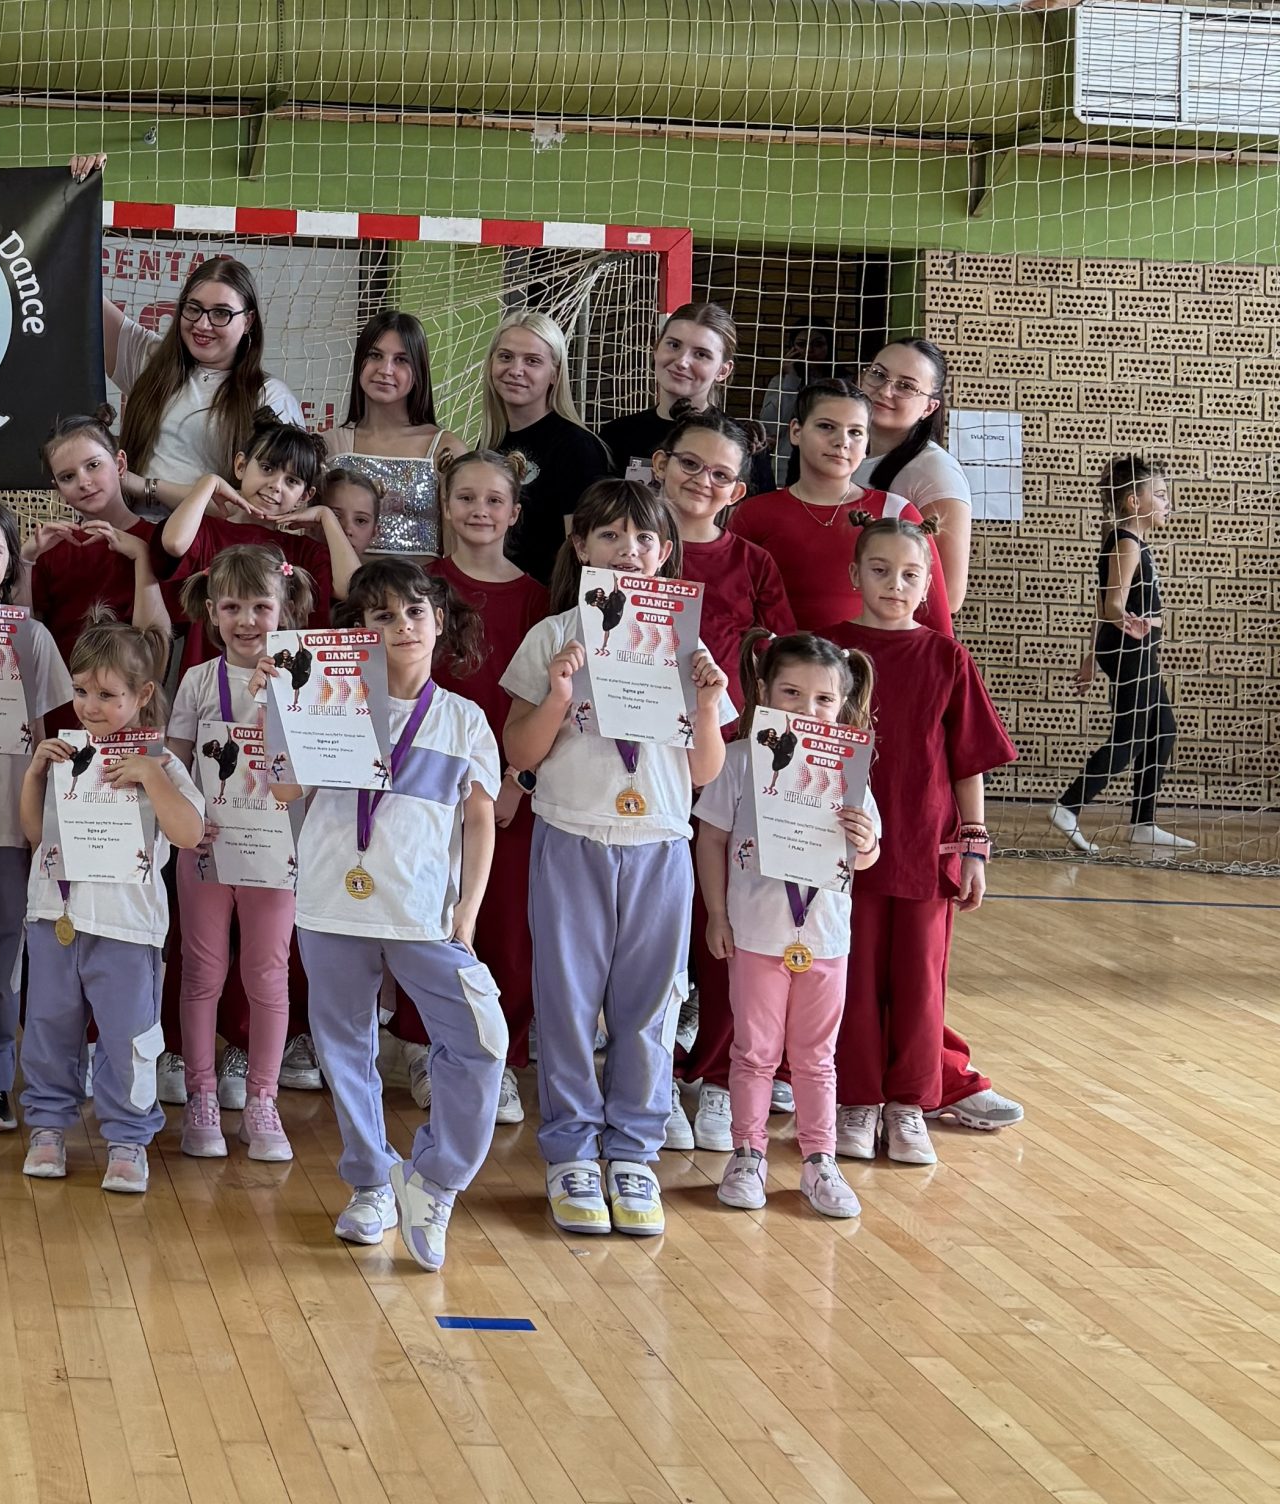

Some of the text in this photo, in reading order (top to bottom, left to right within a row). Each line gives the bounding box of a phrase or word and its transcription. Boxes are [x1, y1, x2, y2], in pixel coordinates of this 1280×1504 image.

[102, 247, 235, 282] ENTA
[623, 578, 653, 591] NOVI
[639, 598, 675, 609] DANCE
[642, 613, 668, 624] NOW
[307, 635, 336, 645] NOVI
[325, 651, 360, 660] DANCE
[617, 649, 654, 666] DIPLOMA
[330, 667, 355, 675] NOW
[308, 704, 347, 716] DIPLOMA
[795, 720, 825, 734] NOVI
[235, 729, 263, 739] NOVI
[810, 741, 846, 754] DANCE
[812, 757, 838, 768] NOW
